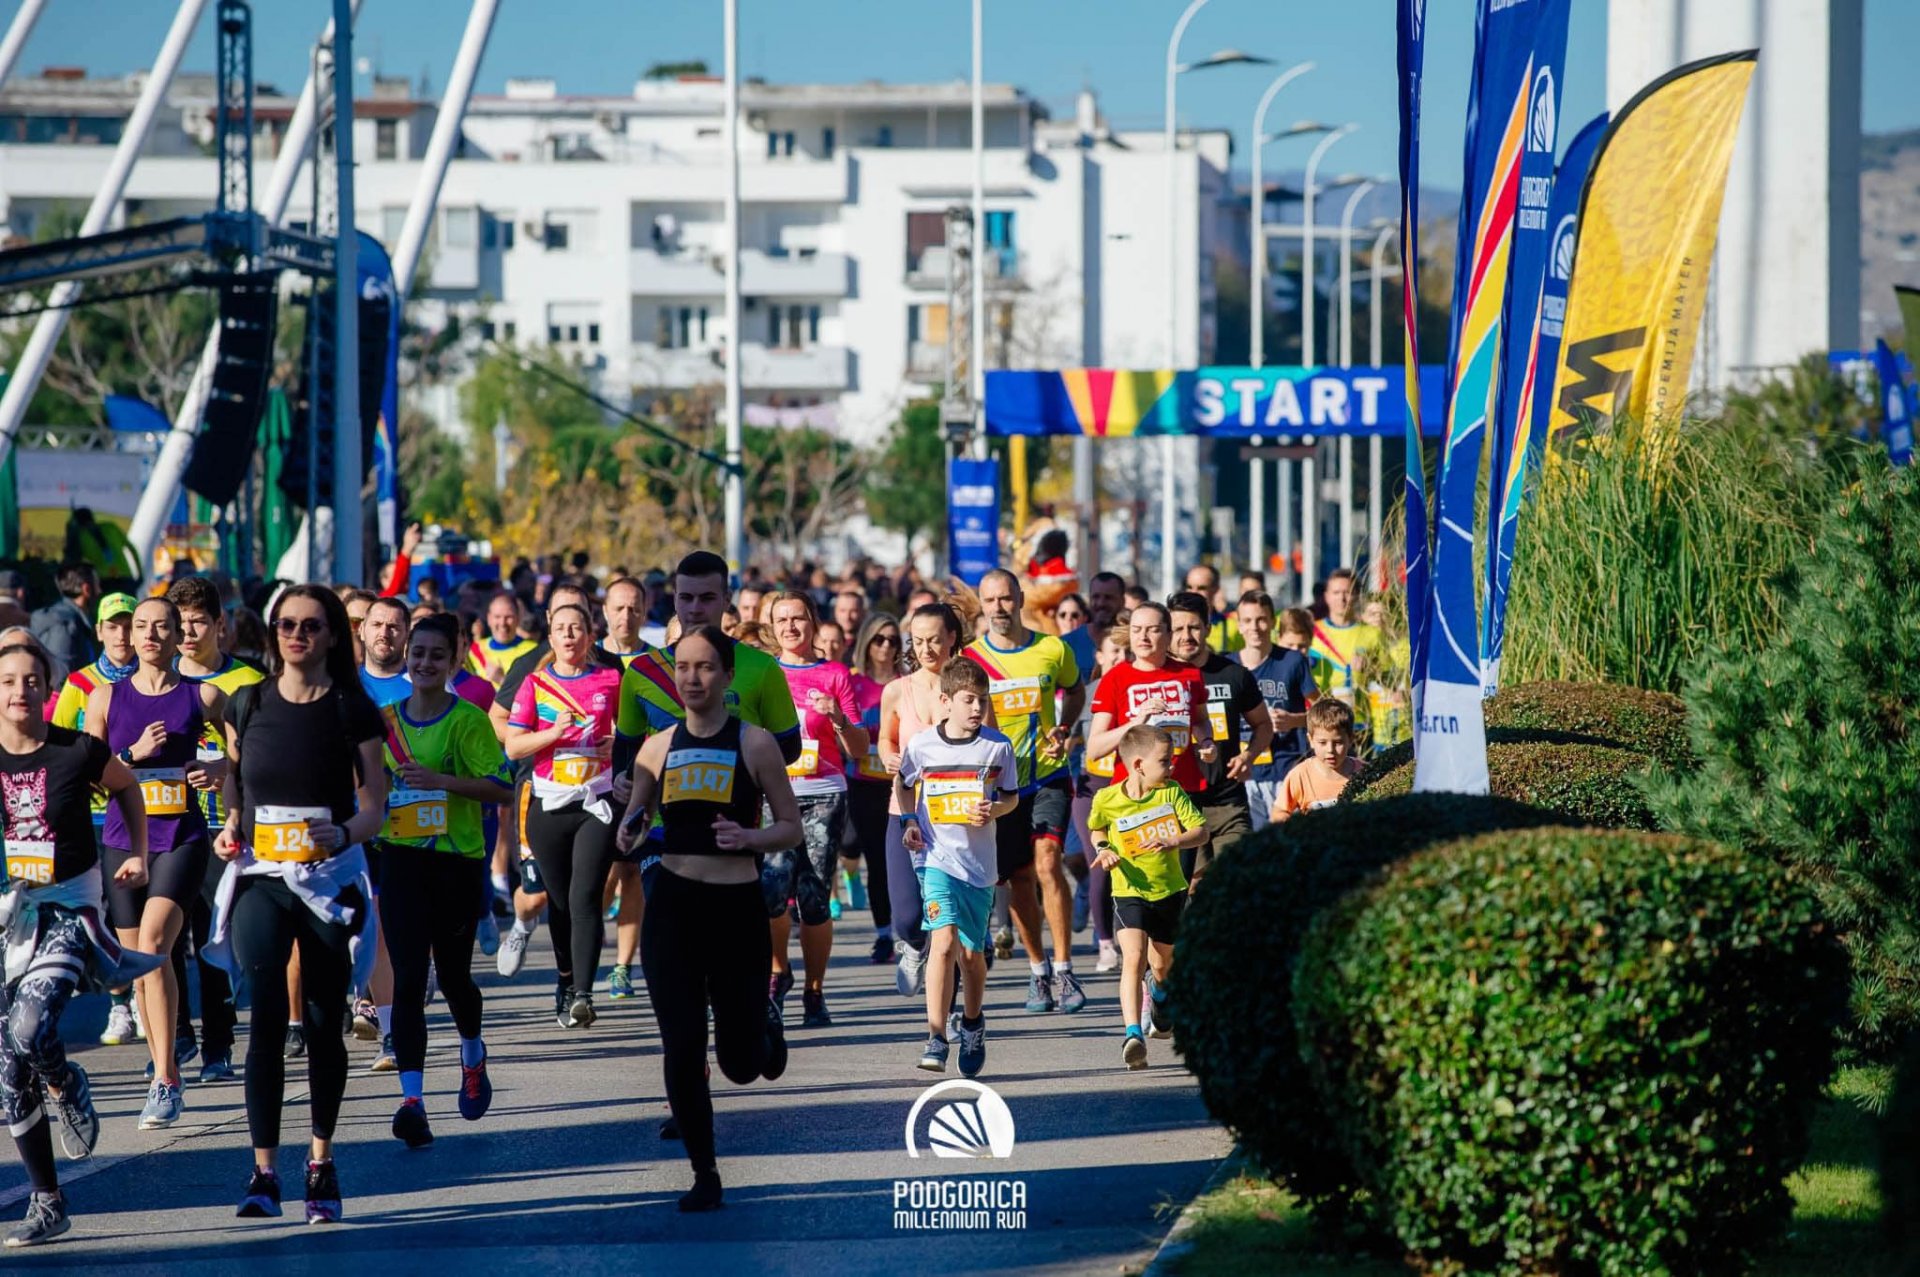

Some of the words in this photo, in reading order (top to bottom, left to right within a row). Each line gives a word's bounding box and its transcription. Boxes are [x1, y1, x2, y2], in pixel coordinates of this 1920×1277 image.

[1672, 257, 1692, 320] MAYER
[1194, 378, 1388, 427] START
[1003, 691, 1038, 710] 217
[12, 772, 35, 783] HATE
[566, 760, 599, 779] 477
[679, 768, 732, 792] 1147
[417, 806, 445, 828] 50
[1136, 819, 1178, 845] 1266
[10, 862, 51, 885] 245
